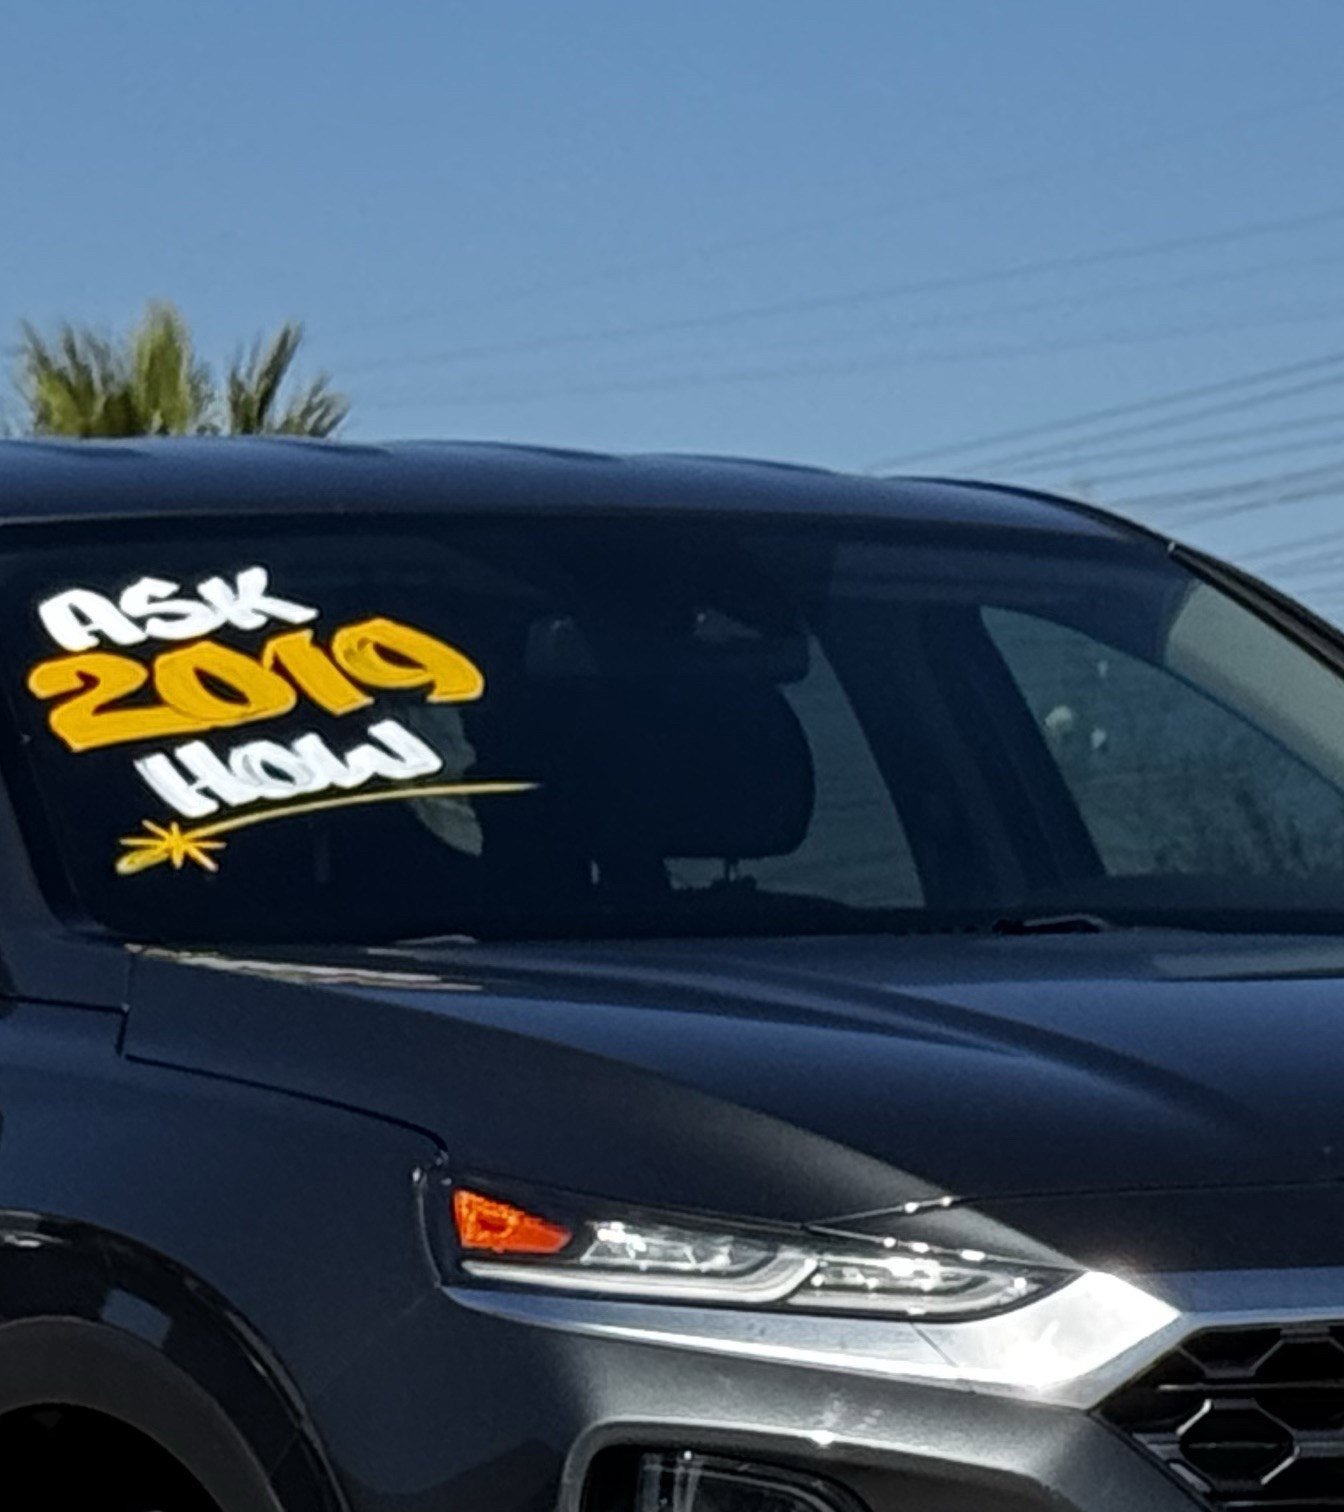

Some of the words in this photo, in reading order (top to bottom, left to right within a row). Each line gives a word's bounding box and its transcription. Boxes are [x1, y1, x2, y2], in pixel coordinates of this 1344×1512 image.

[38, 566, 319, 651] ASK
[28, 618, 485, 752] 2019
[134, 719, 443, 819] HOW
